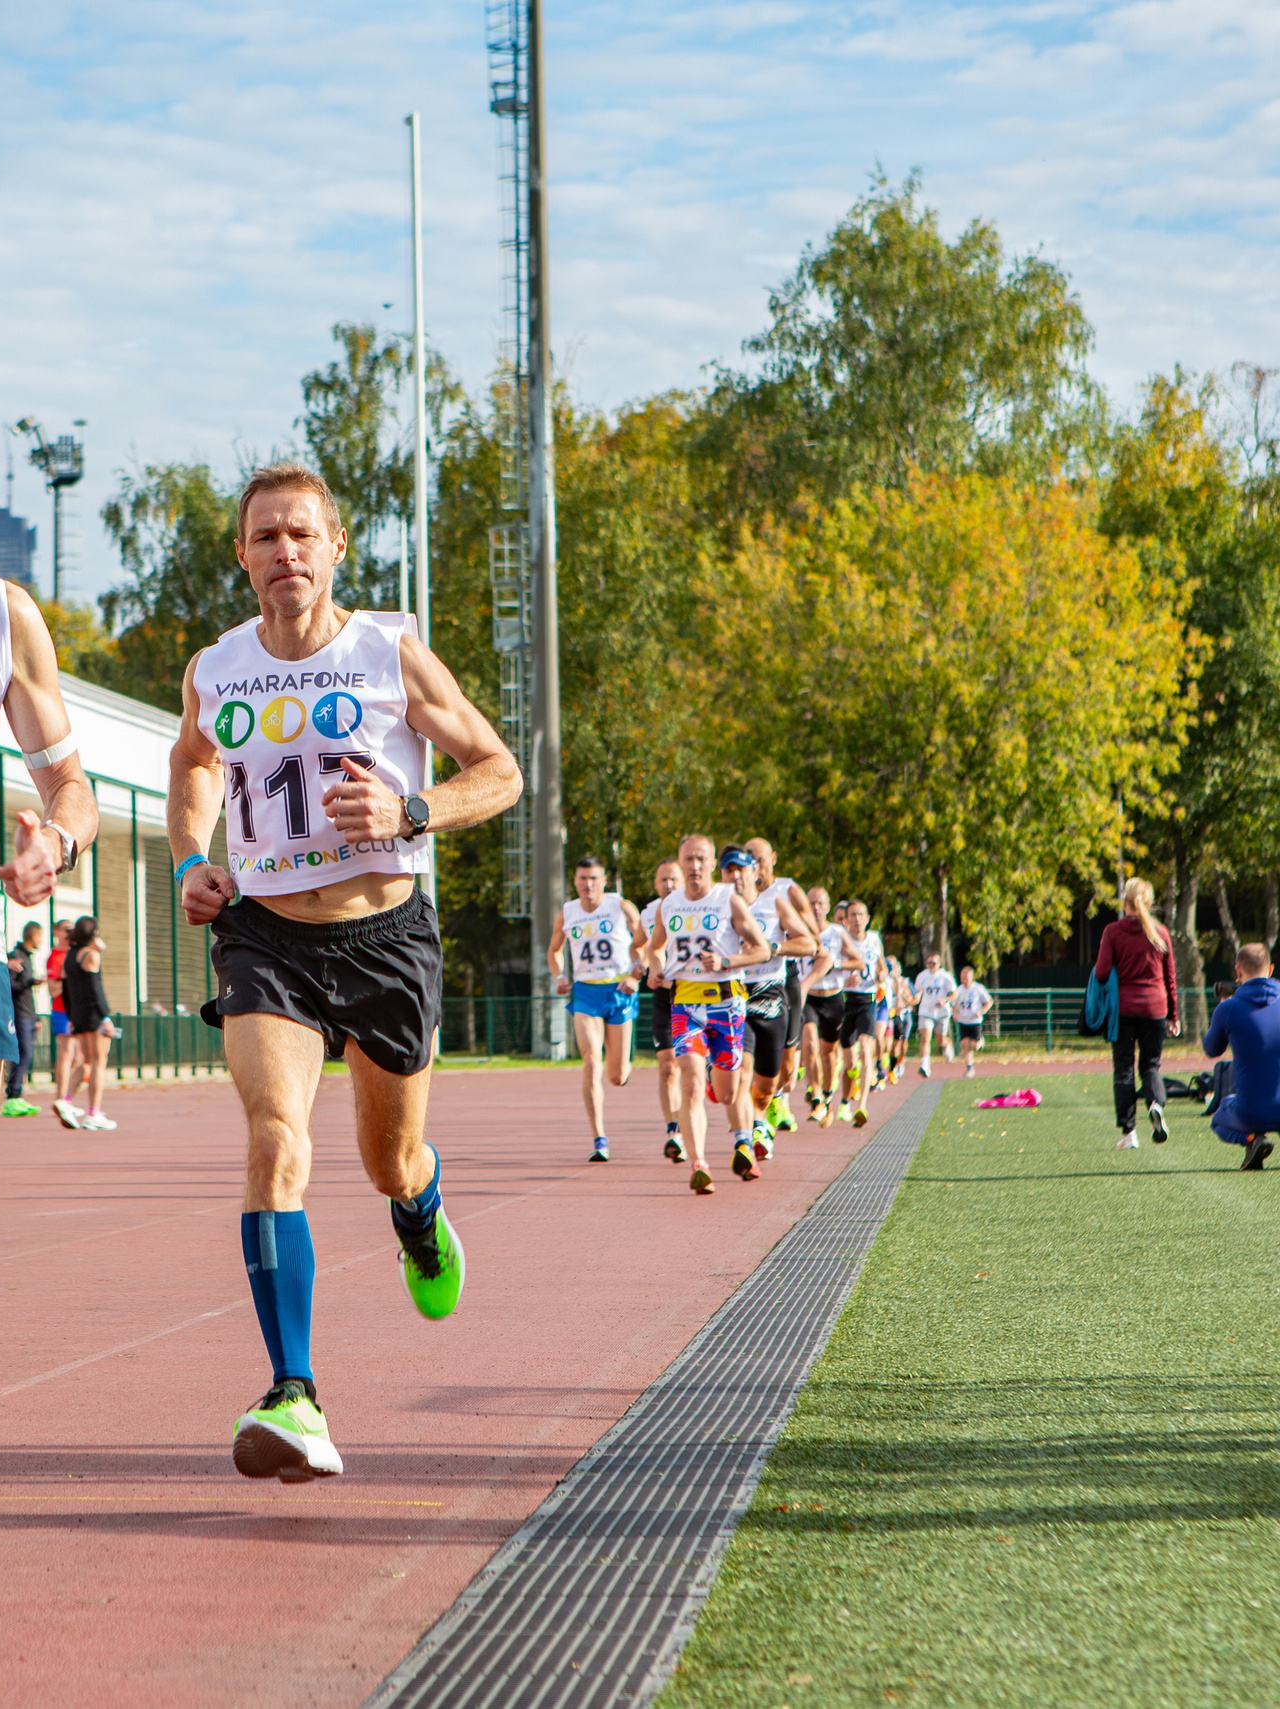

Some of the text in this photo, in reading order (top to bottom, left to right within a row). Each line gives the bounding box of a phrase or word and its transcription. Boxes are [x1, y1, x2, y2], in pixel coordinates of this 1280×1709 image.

[216, 671, 366, 697] VMARAFONE
[580, 938, 613, 964] 49
[675, 935, 714, 962] 53
